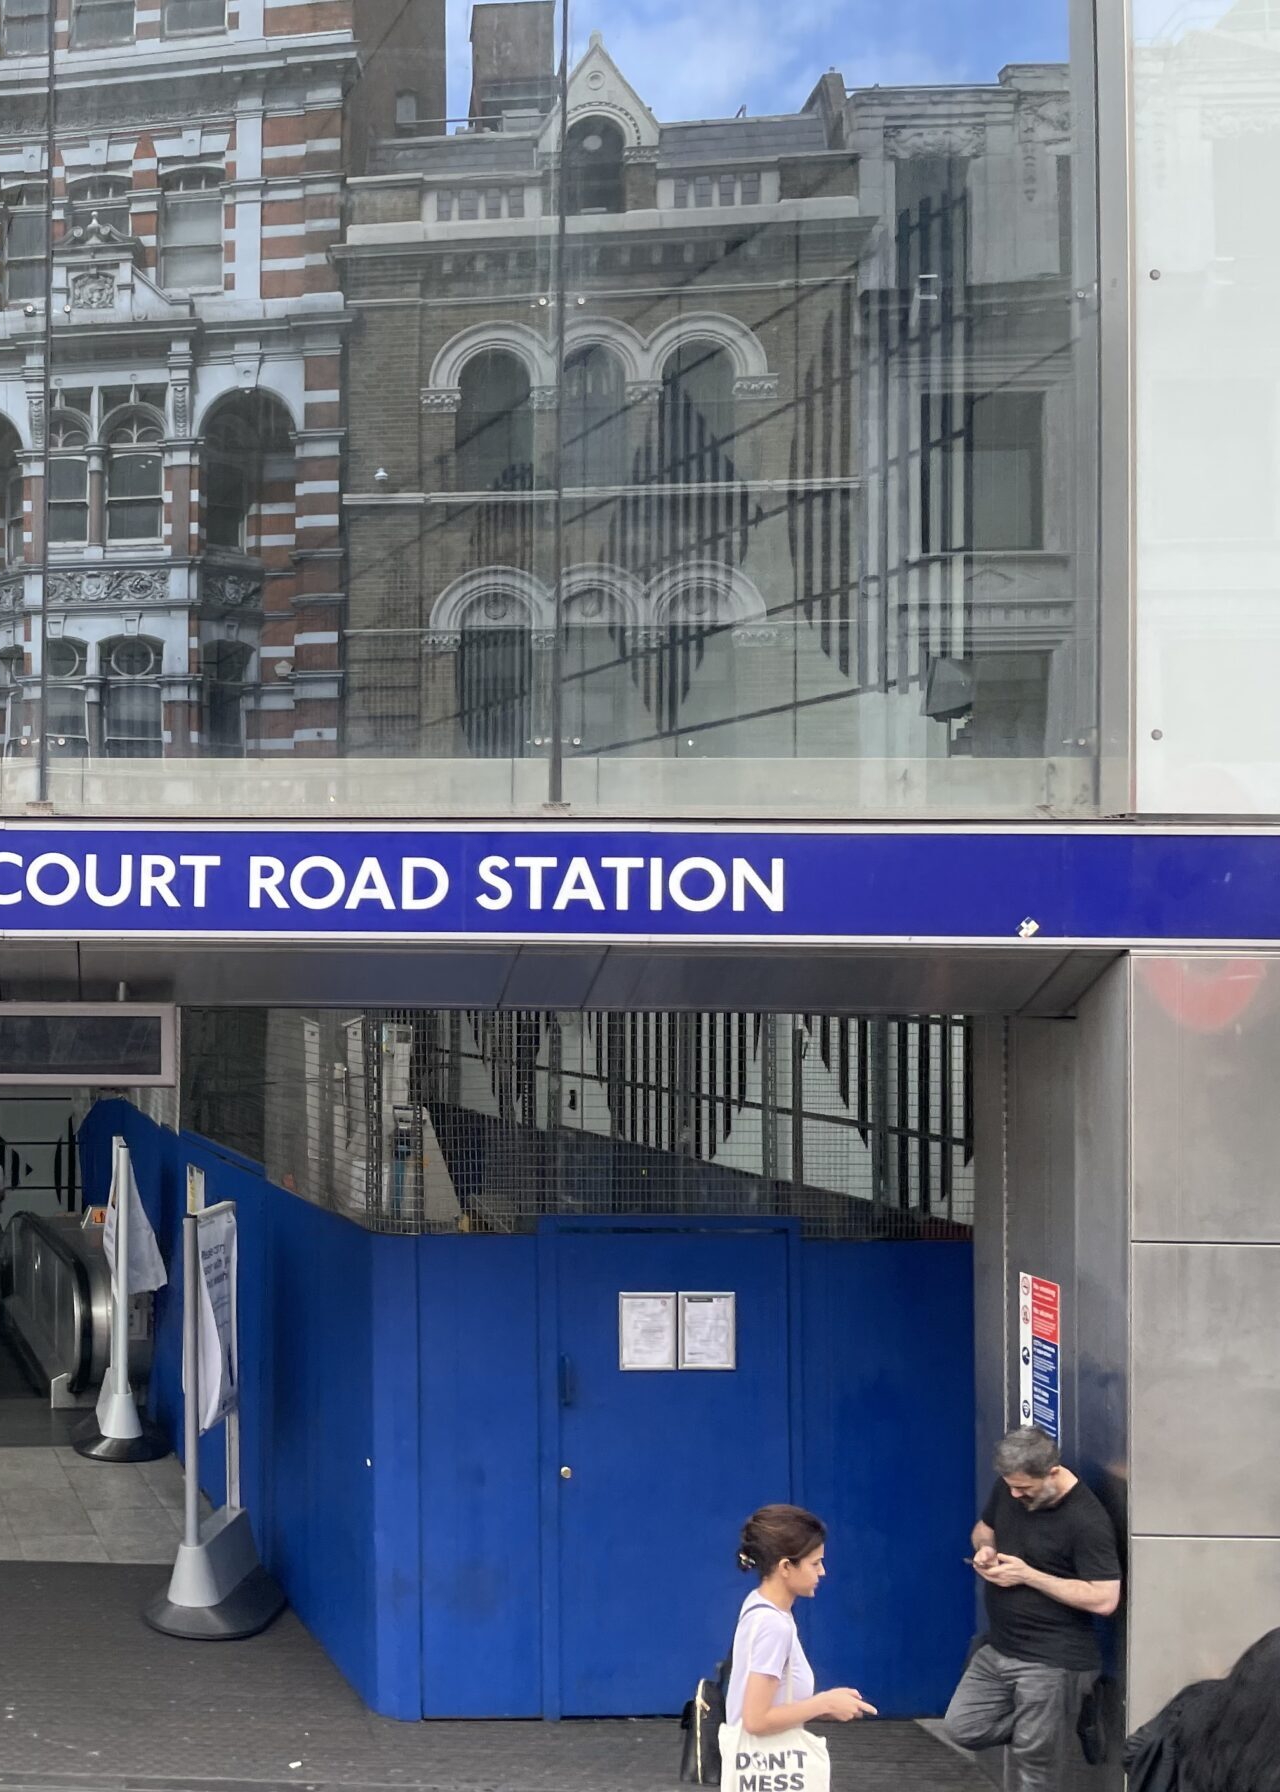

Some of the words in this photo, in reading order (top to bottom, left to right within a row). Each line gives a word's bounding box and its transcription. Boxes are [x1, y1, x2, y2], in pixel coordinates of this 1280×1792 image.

[248, 855, 450, 910] ROAD
[475, 855, 785, 912] STATION
[739, 1773, 805, 1792] MESS
